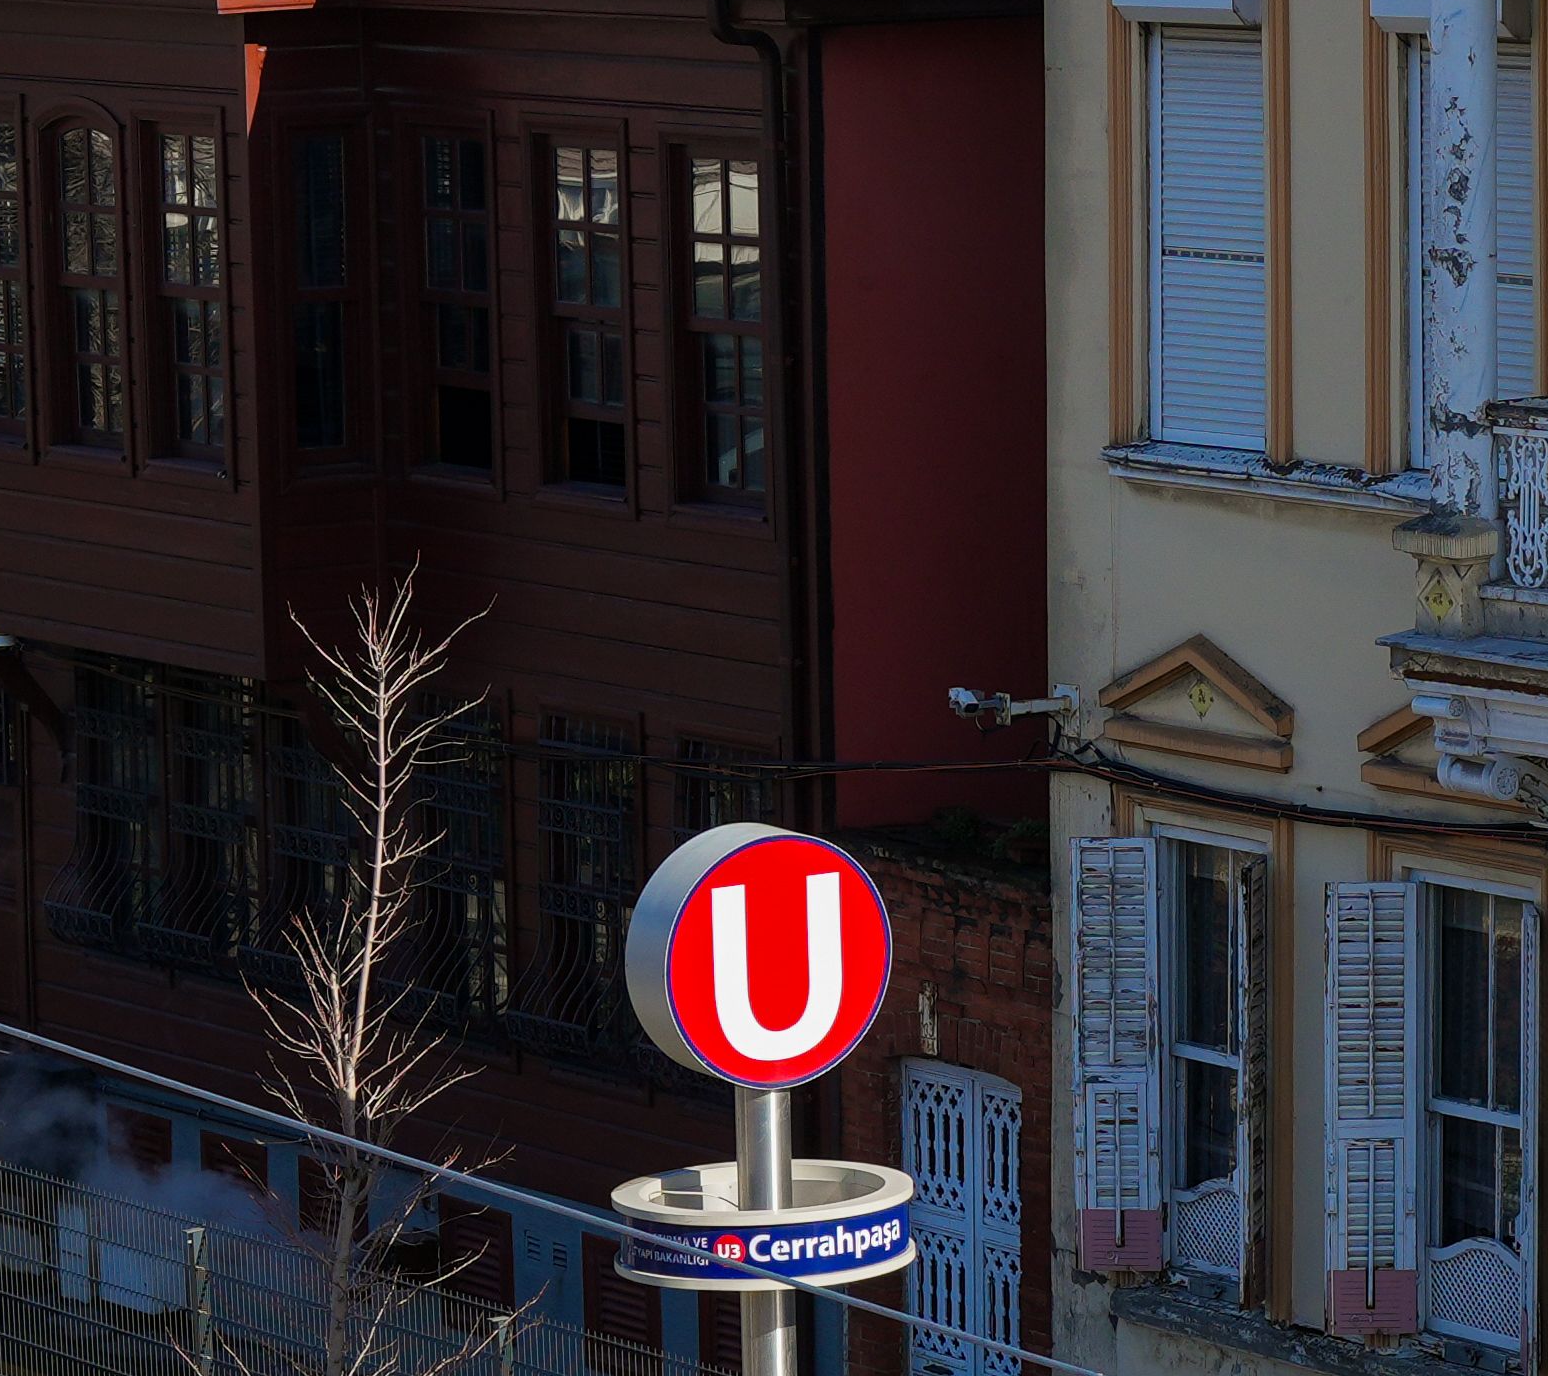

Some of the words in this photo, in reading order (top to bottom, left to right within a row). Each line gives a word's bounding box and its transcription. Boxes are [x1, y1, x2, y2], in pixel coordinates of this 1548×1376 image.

[710, 871, 844, 1061] U
[716, 1243, 742, 1260] U3
[748, 1218, 901, 1262] Cerrahpaşa
